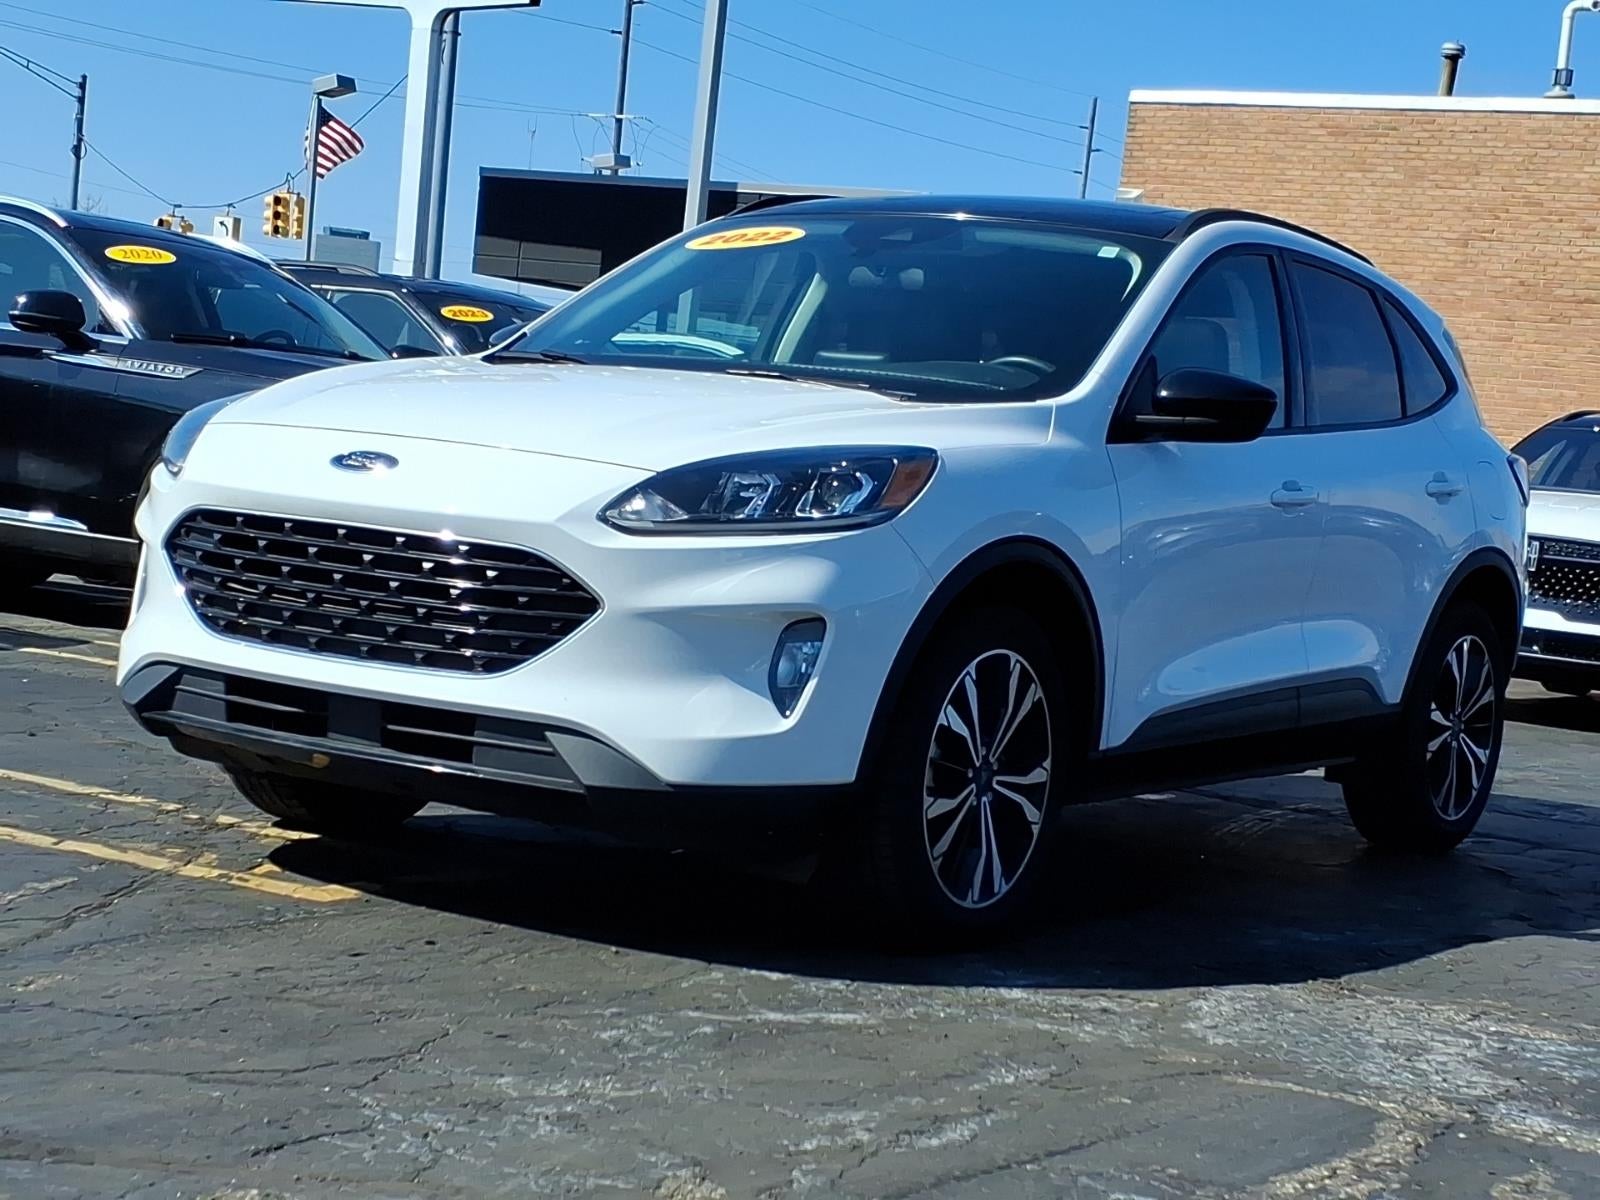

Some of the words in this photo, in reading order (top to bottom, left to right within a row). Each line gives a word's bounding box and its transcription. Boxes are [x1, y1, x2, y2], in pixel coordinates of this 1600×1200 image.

[698, 230, 793, 247] 2022
[118, 249, 162, 260] 2020
[126, 360, 184, 374] AVIATOR
